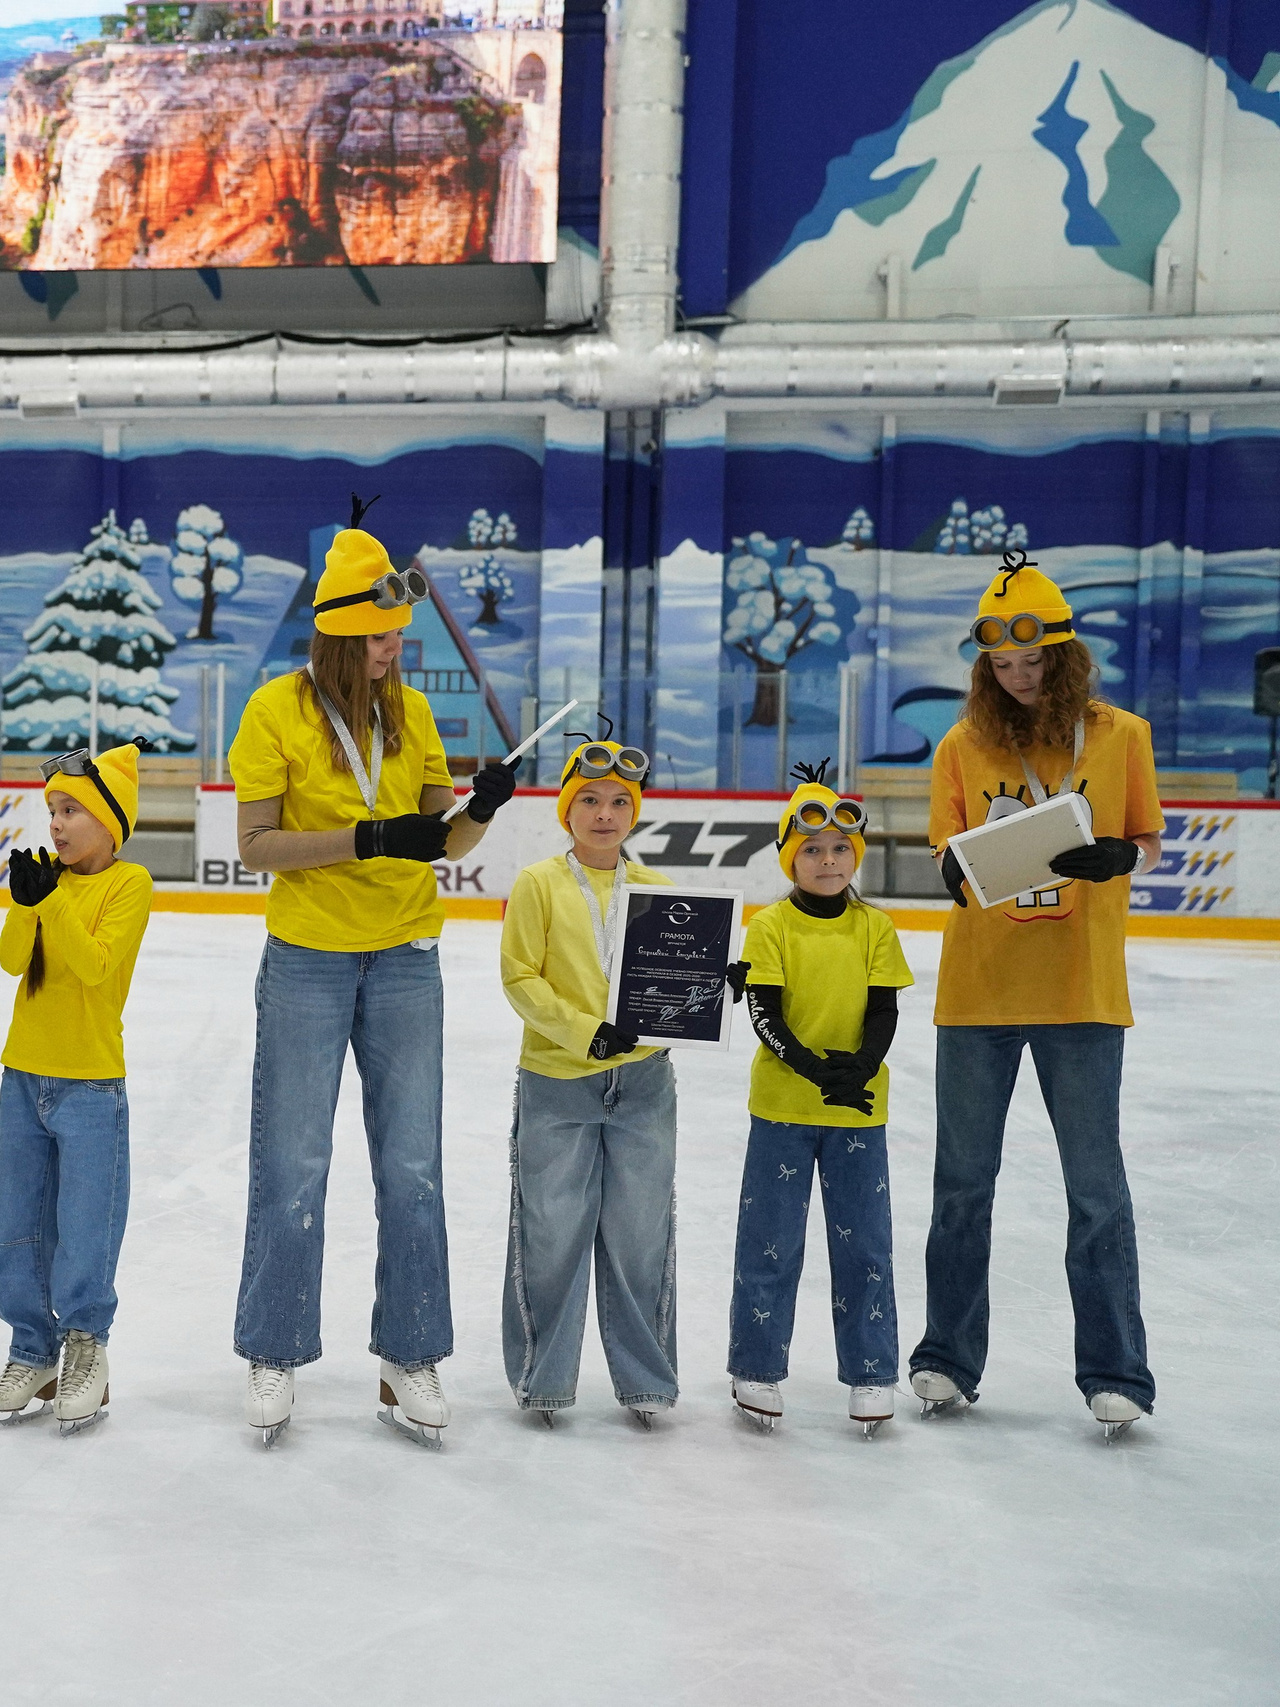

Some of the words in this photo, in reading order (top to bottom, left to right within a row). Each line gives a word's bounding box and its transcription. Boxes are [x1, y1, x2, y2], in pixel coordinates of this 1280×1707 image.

[432, 865, 484, 892] RK
[660, 932, 695, 941] ГРАМОТА
[757, 1018, 786, 1059] knives
